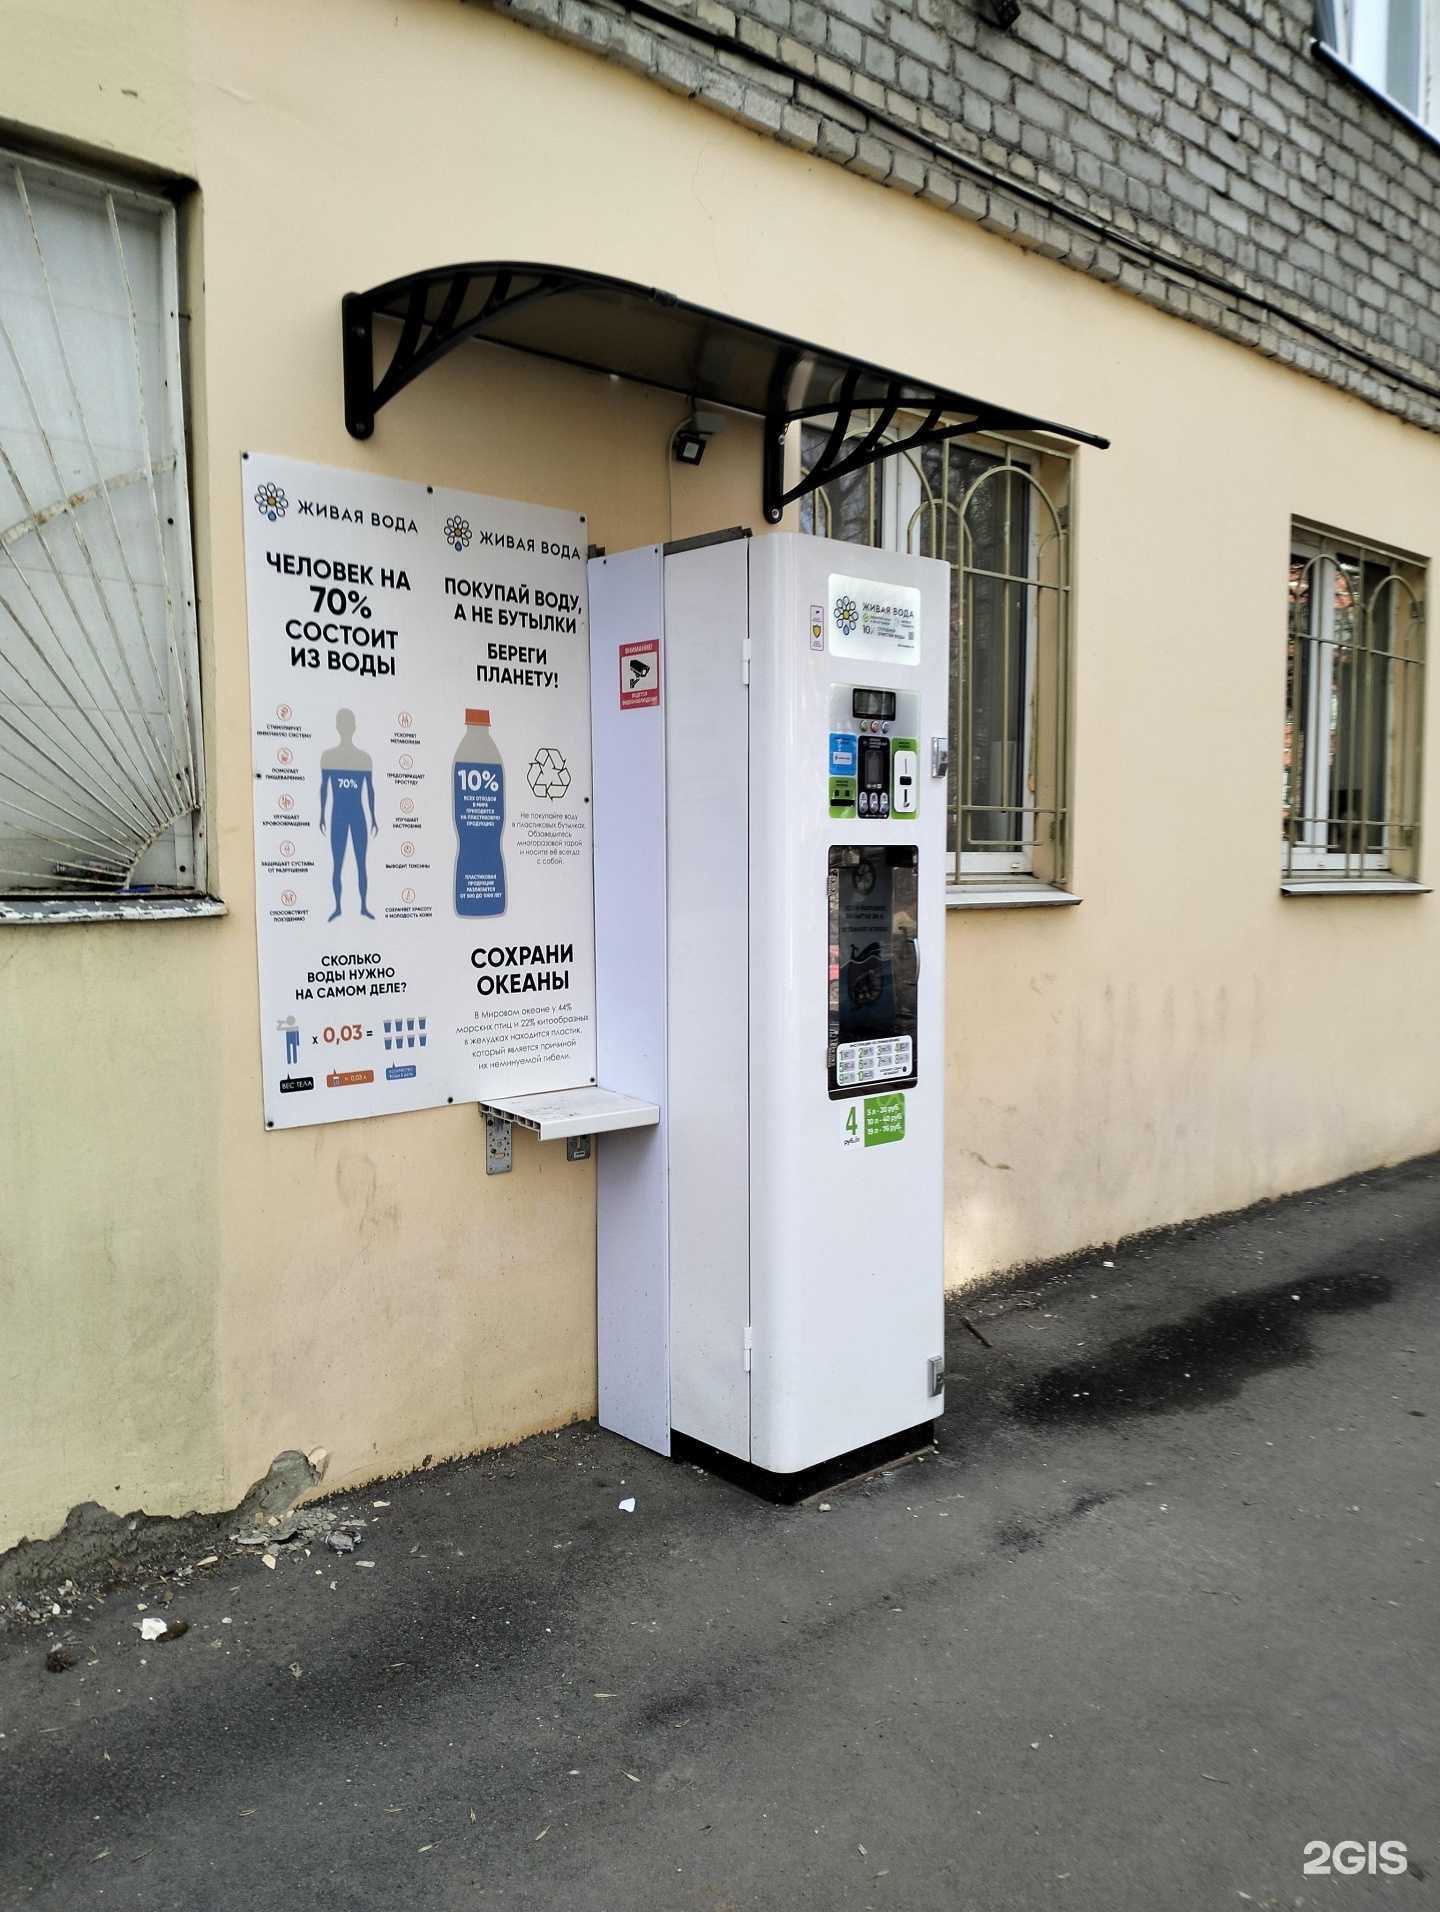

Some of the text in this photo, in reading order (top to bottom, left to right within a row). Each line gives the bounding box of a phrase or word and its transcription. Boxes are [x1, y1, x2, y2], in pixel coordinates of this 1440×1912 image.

[297, 499, 419, 534] ЖИВАЯ ВОДА
[479, 530, 581, 561] ЖИВАЯ ВОДА
[265, 551, 411, 591] ЧЕЛОВЕК НА
[309, 585, 372, 619] 70%
[444, 577, 583, 615] ПОКУПАЙ ВОДУ,
[454, 603, 577, 634] А НЕ БУТЫЛКИ
[863, 602, 914, 618] ЖИВАЯ ВОДА
[285, 618, 399, 650] СОСТОИТ
[290, 646, 397, 677] ИЗ ВОДЫ
[487, 643, 548, 665] БЕРЕГИ
[476, 664, 559, 689] ПЛАНЕТУ!
[338, 778, 358, 789] 70%
[458, 769, 499, 792] 10%
[321, 953, 381, 967] СКОЛЬКО
[471, 944, 574, 968] СОХРАНИ
[307, 967, 395, 983] ВОДЫ НУЖНО
[477, 970, 569, 996] ОКЕАНЫ
[296, 982, 407, 1000] НА САМОМ ДЕЛЕ?
[474, 1011, 479, 1020] В
[481, 1008, 520, 1021] Мировом
[521, 1006, 550, 1015] океане
[558, 1003, 572, 1011] 44%
[323, 1024, 363, 1045] 0,03
[456, 1024, 493, 1035] морских
[521, 1018, 536, 1028] 22%
[510, 1031, 550, 1041] находится
[472, 1047, 506, 1058] который
[478, 1062, 488, 1070] их
[845, 1105, 858, 1136] 4
